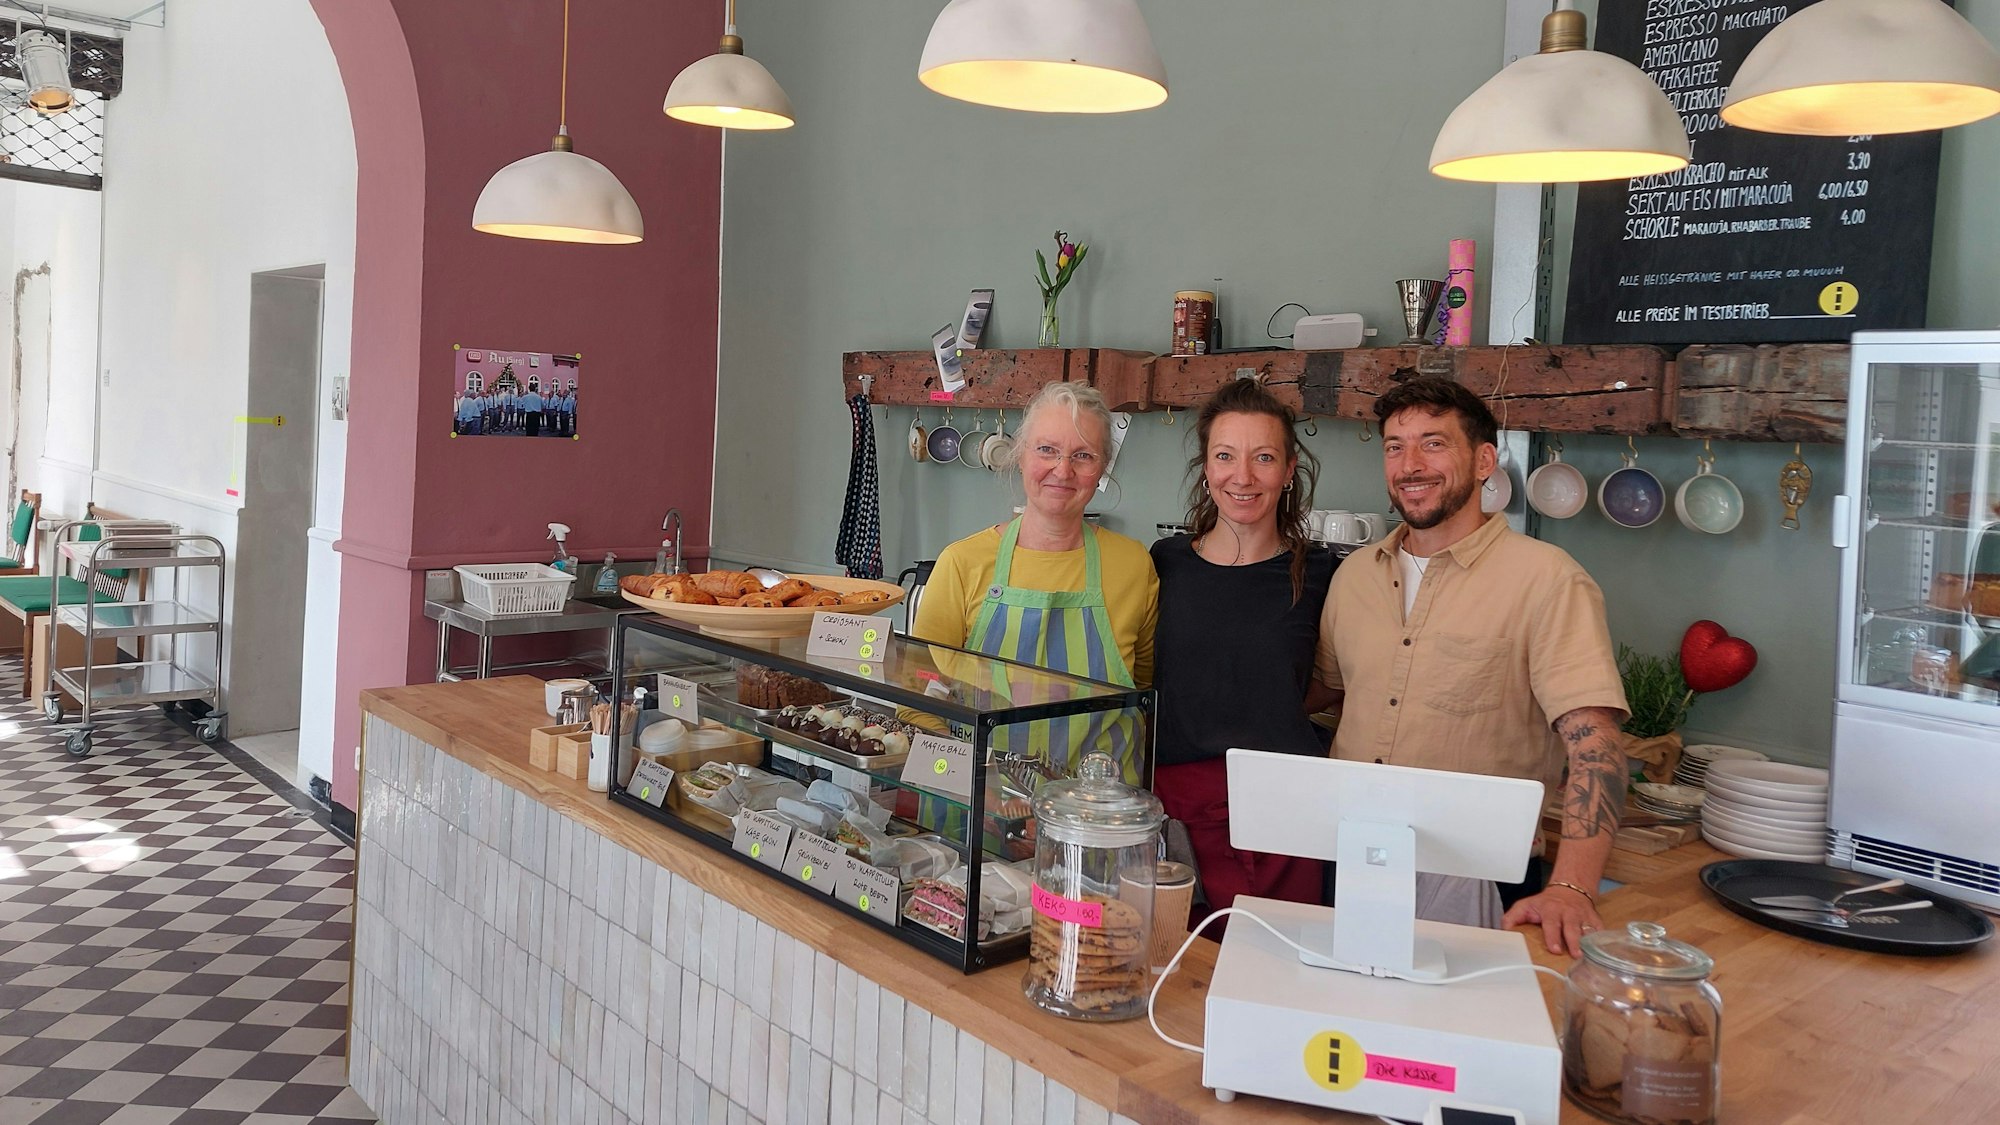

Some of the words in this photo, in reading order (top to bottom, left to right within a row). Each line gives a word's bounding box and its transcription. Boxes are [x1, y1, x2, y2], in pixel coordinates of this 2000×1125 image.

[1643, 12, 1718, 45] ESPRESSO
[1722, 6, 1787, 31] MACCHIATO
[1641, 37, 1719, 69] AMERICANO
[1746, 166, 1769, 180] ALK
[1625, 191, 1667, 216] SEKT
[1664, 190, 1692, 212] AUF
[1692, 187, 1711, 211] EIS
[1720, 187, 1739, 209] MIT
[1623, 216, 1681, 240] SCHORLE
[1780, 216, 1812, 230] TRAUBE
[1619, 275, 1640, 287] ALLE
[1643, 272, 1722, 287] HEISSGETRÄNKE
[1727, 271, 1748, 281] MIT
[1750, 270, 1783, 280] HAFER
[1803, 265, 1844, 278] MUUUH
[1615, 310, 1642, 323] ALLE
[1645, 306, 1681, 322] PREISE
[1684, 304, 1698, 321] IM
[1700, 302, 1769, 321] TESTBETRIEB
[1038, 892, 1067, 916] KEKS
